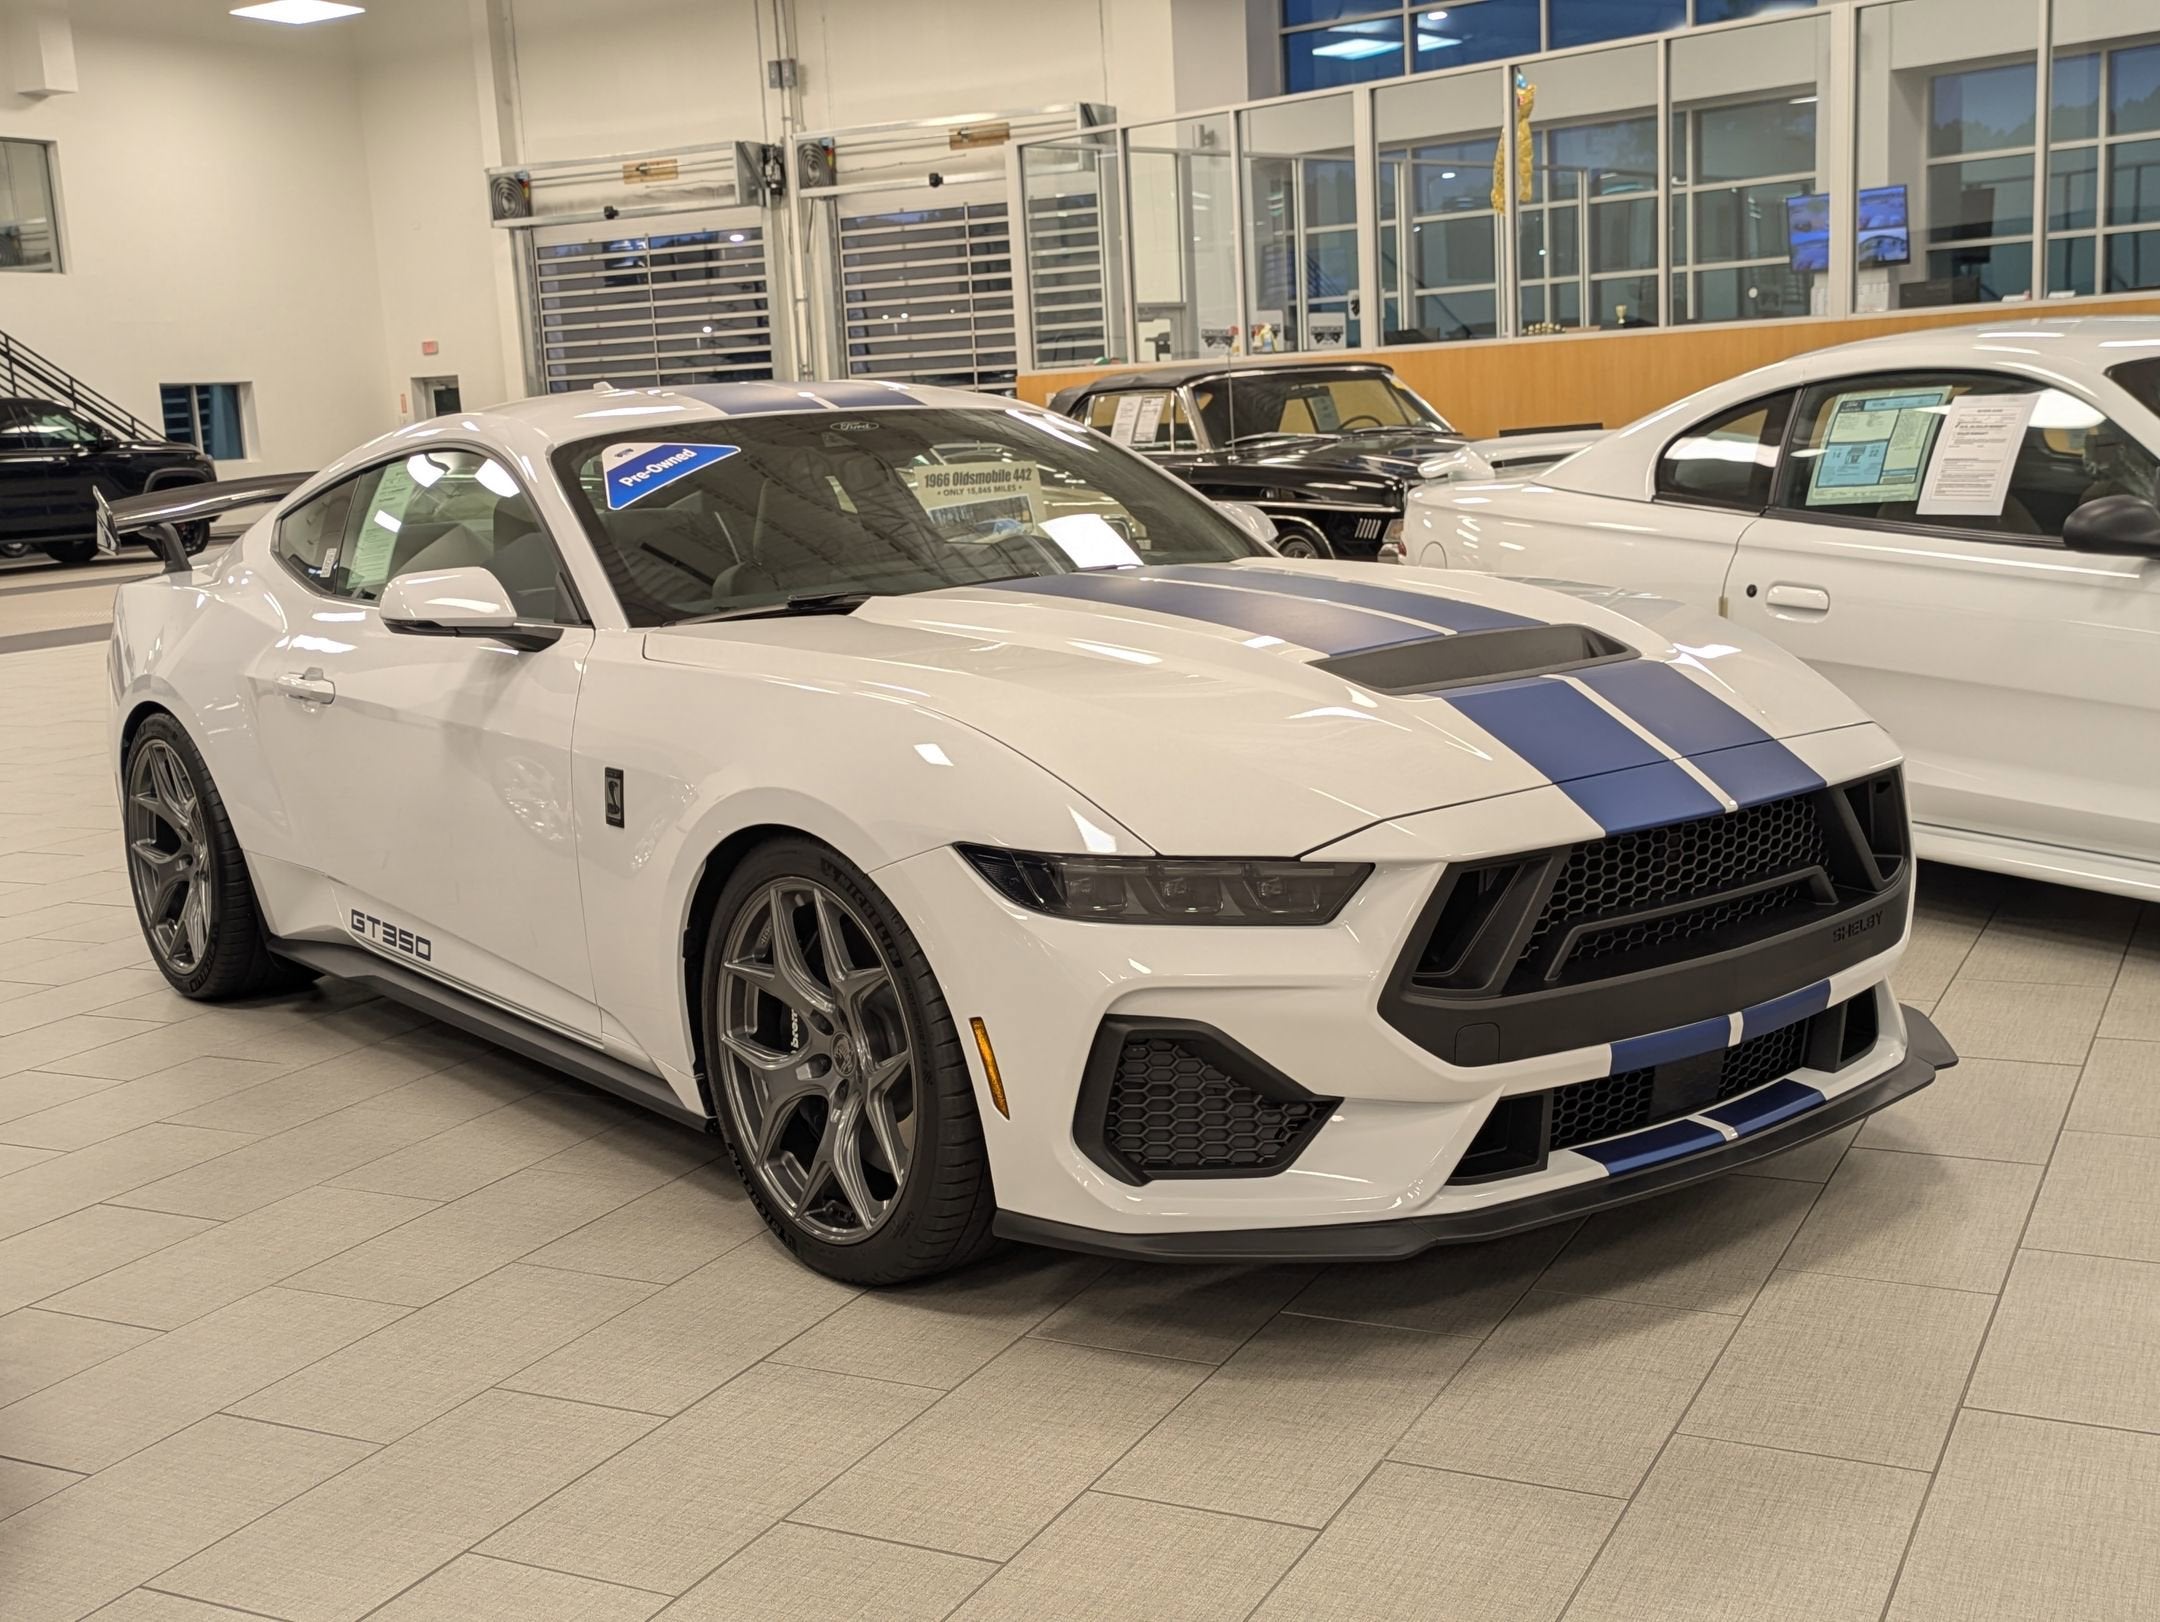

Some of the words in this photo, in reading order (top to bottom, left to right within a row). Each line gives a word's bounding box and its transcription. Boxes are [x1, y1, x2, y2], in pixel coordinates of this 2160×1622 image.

[838, 421, 873, 431] Ford
[618, 448, 698, 487] Pre-Owned
[925, 472, 950, 488] 1966
[952, 469, 1012, 486] Oldsmobile
[1013, 467, 1032, 482] 442
[943, 488, 964, 497] ONLY
[993, 484, 1016, 493] MILES
[351, 908, 431, 962] GT350
[836, 871, 902, 966] MICHELIN
[1832, 910, 1884, 943] SHELBY
[790, 1008, 799, 1048] brem
